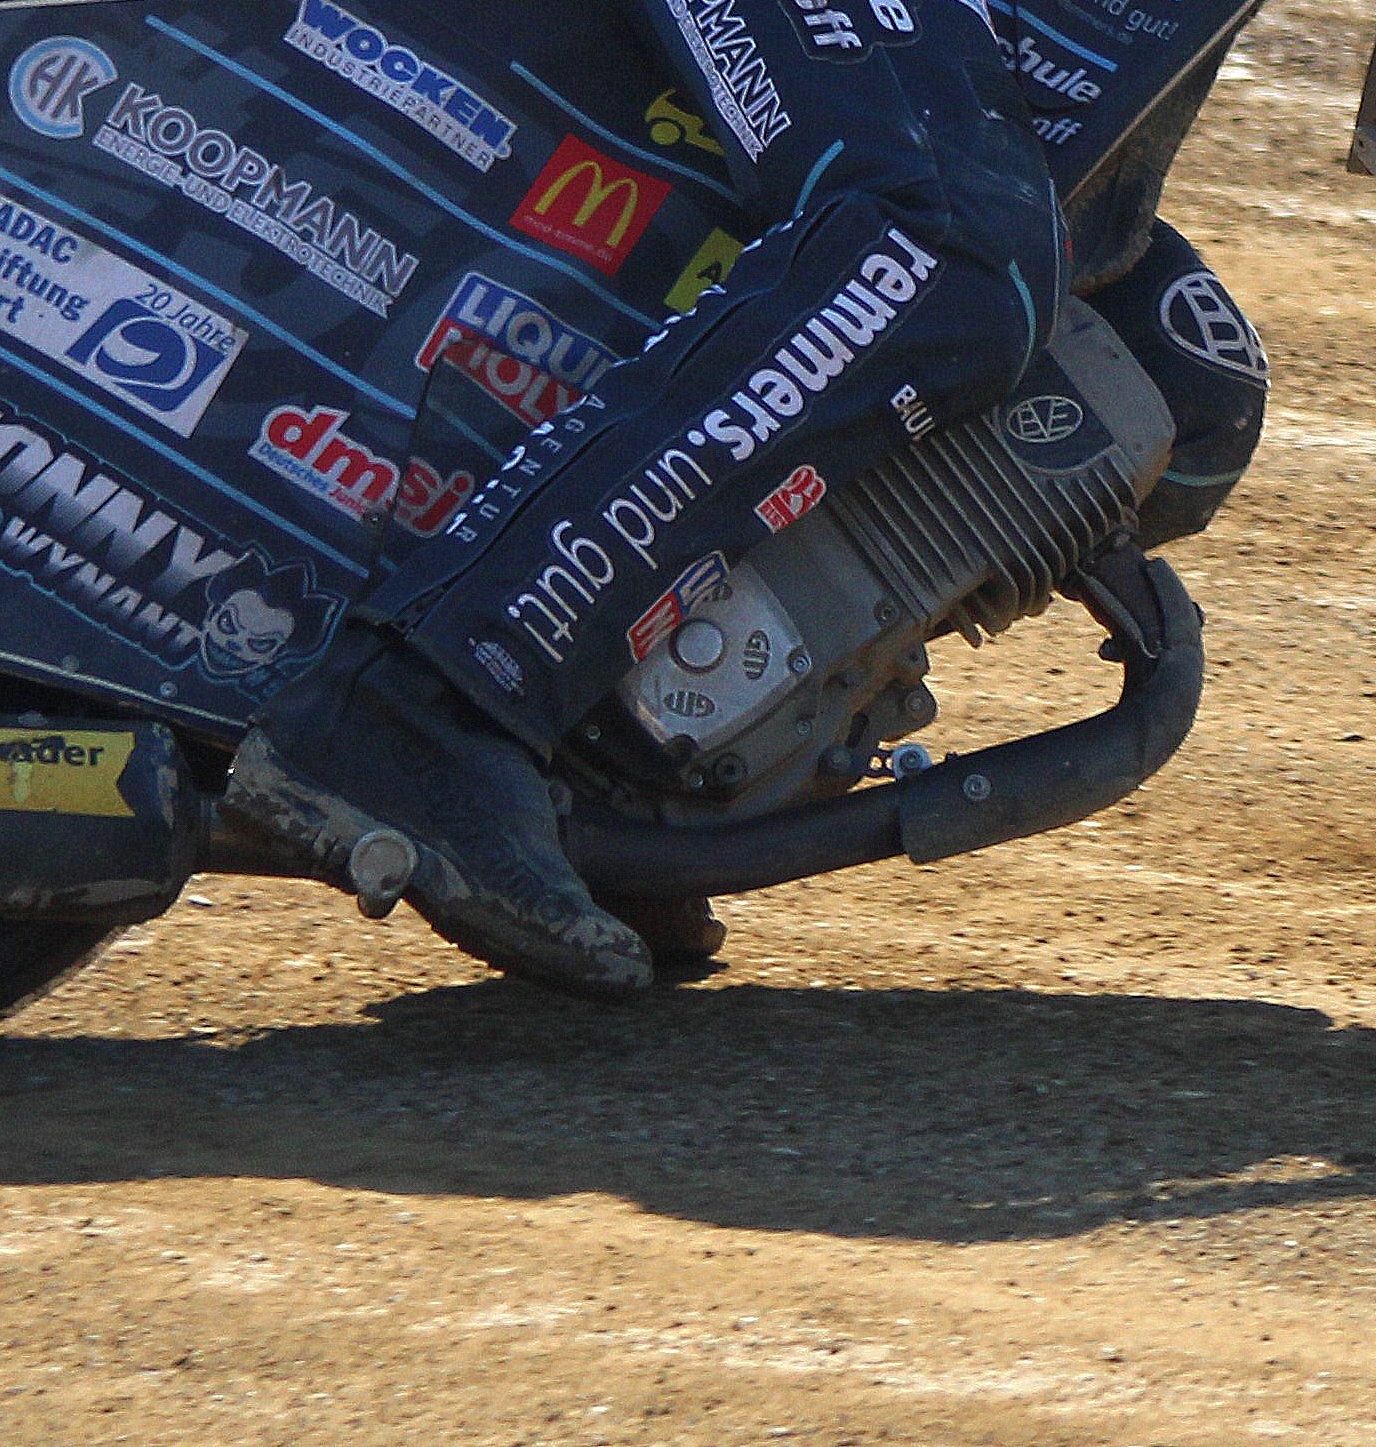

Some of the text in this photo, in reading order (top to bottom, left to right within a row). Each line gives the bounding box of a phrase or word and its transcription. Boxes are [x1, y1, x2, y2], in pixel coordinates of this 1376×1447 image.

[288, 27, 496, 169] INDUSTRIEPARTNER
[106, 81, 420, 297] KOOPMANN
[135, 283, 237, 351] 20 Jahre
[458, 283, 612, 391] LIQUI
[688, 226, 938, 462] remmers.
[268, 411, 472, 533] dmsj
[601, 448, 713, 571] und
[507, 519, 616, 663] gut!
